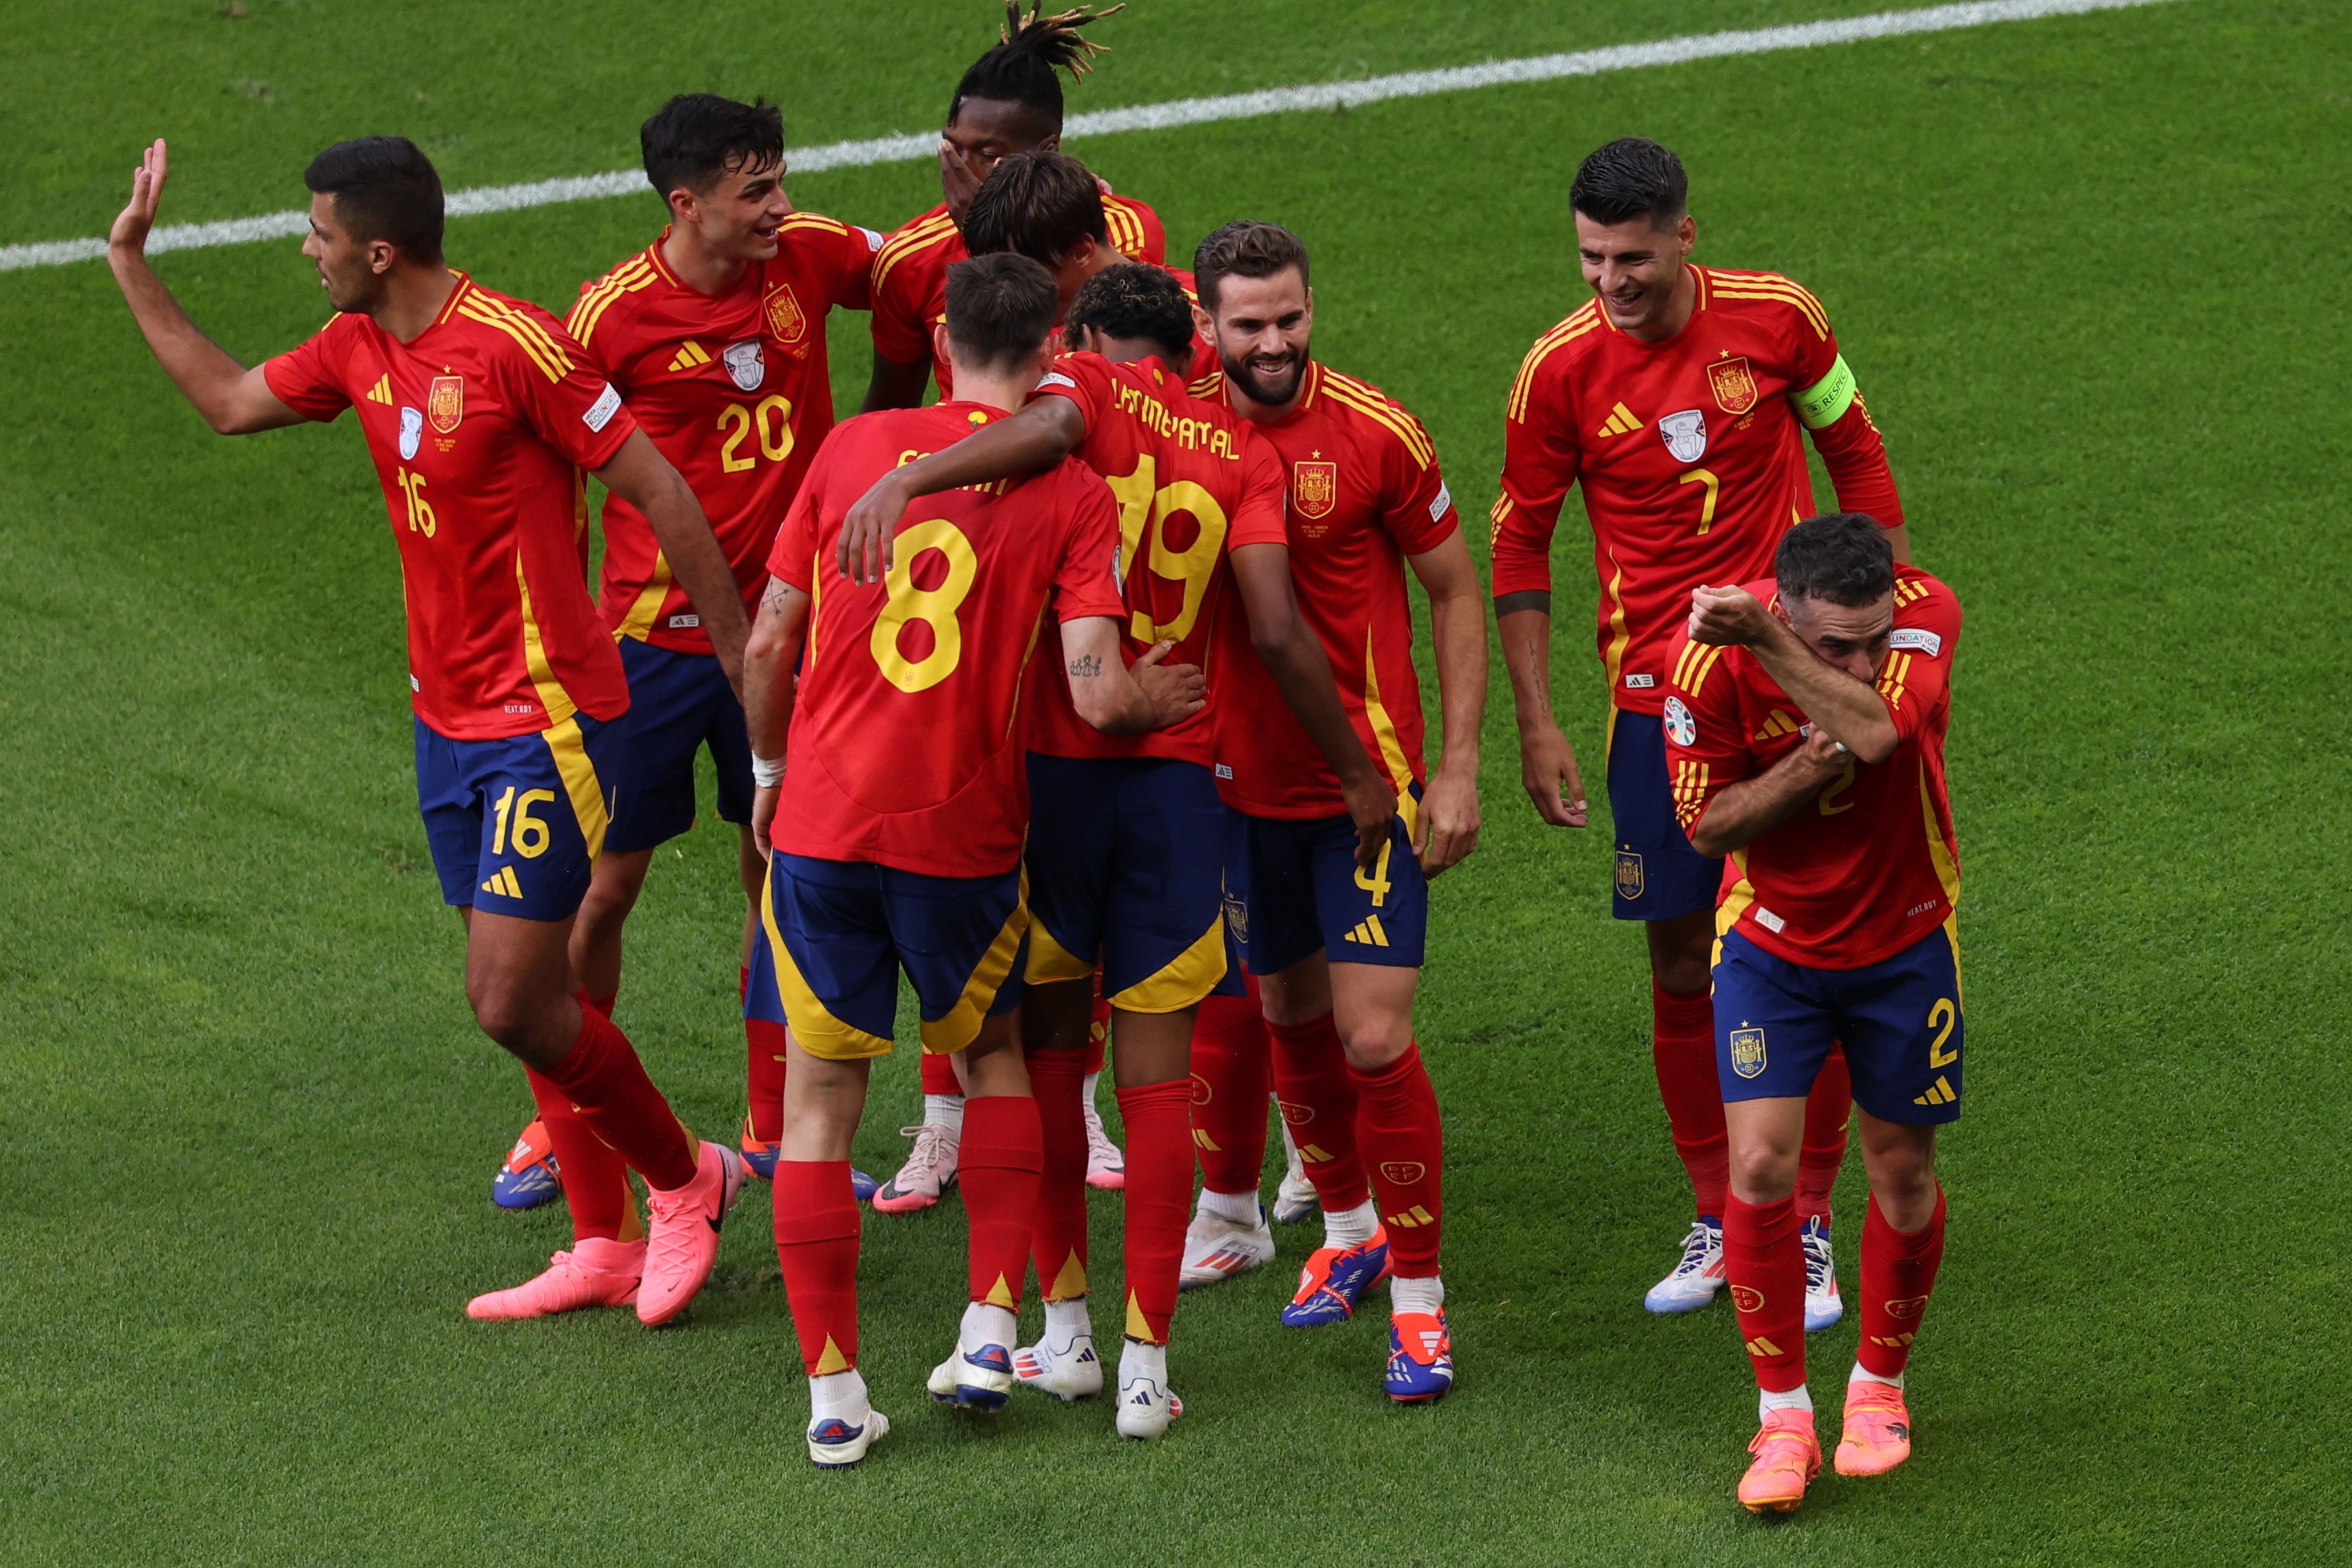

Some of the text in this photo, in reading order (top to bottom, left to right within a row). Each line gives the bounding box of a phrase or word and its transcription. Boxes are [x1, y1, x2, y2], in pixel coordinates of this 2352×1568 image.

[1822, 366, 1847, 406] RESPECT
[717, 394, 794, 473] 20
[397, 466, 436, 538] 16
[1679, 468, 1719, 536] 7
[1105, 453, 1228, 645] 19
[870, 519, 978, 694] 8
[504, 704, 532, 713] HEAT.RDY
[492, 786, 556, 859] 16
[1819, 761, 1855, 816] 2
[1353, 838, 1392, 907] 4
[1907, 899, 1936, 918] HEAT.RDY
[1927, 997, 1958, 1069] 2
